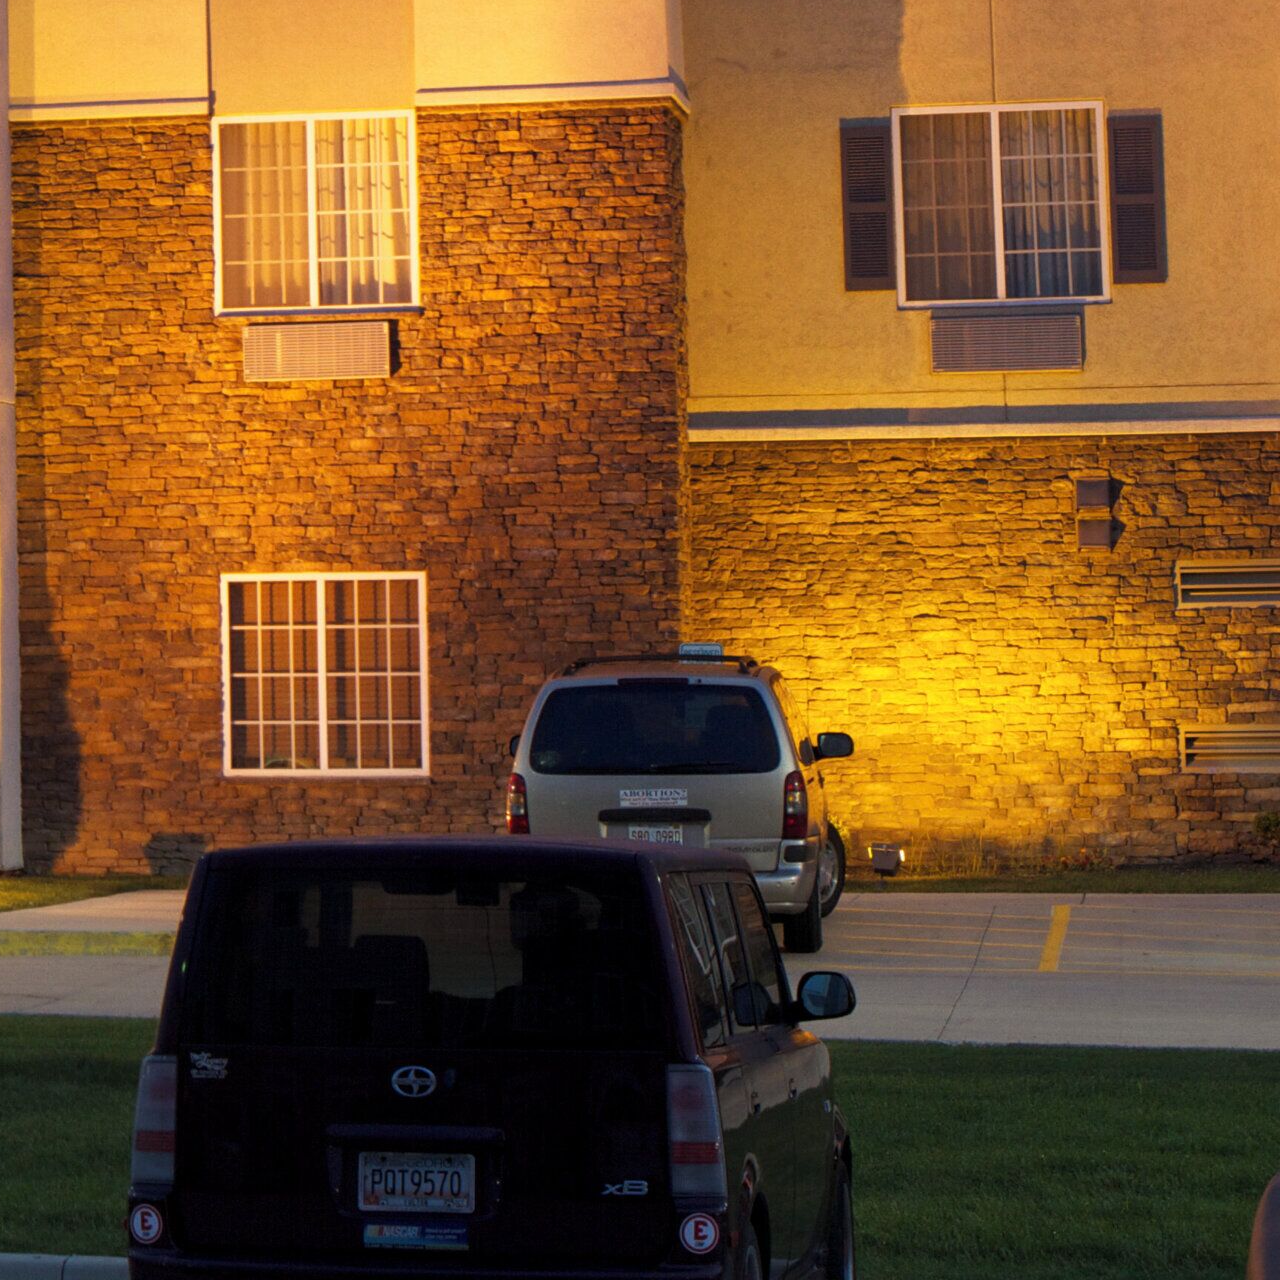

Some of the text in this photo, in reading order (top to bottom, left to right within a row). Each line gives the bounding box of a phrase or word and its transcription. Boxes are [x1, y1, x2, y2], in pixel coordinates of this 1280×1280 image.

[623, 789, 686, 798] ABORTION?
[371, 1169, 462, 1197] PQT9570
[601, 1180, 648, 1196] xB
